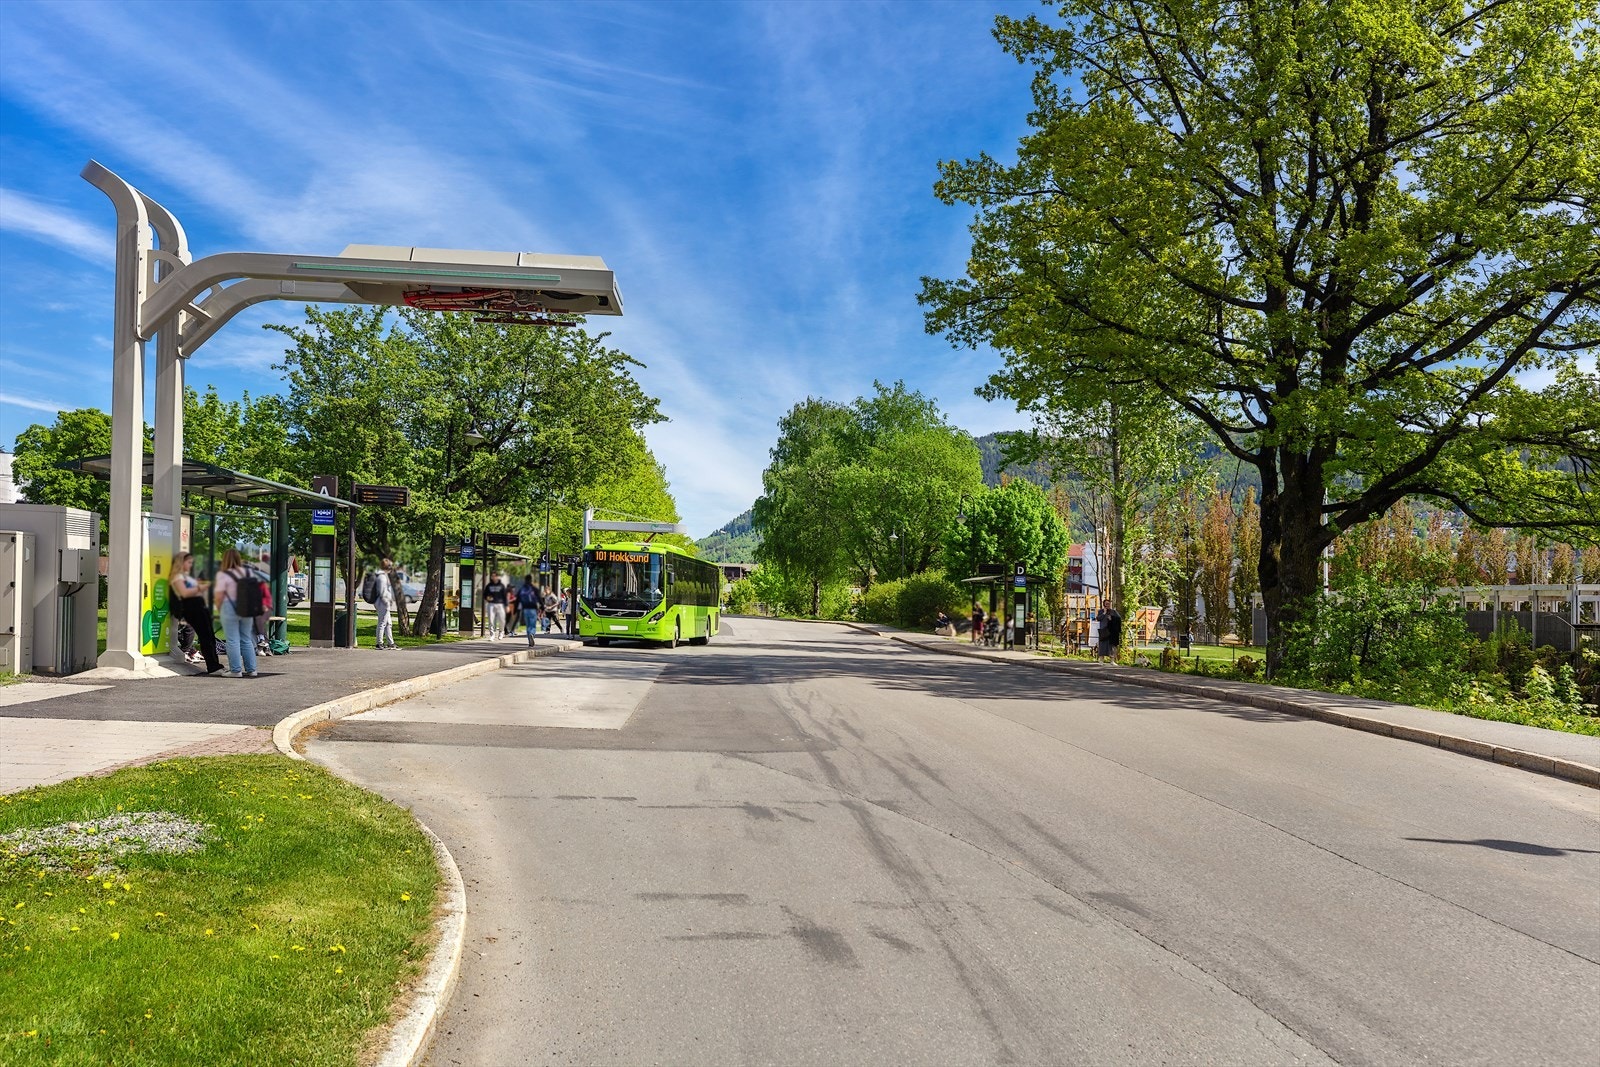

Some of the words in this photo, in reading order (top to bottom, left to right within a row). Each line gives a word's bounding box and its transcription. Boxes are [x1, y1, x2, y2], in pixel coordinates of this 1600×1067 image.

[319, 485, 329, 497] A
[596, 551, 607, 561] 101
[609, 551, 650, 563] Hokksund
[1017, 566, 1024, 575] D
